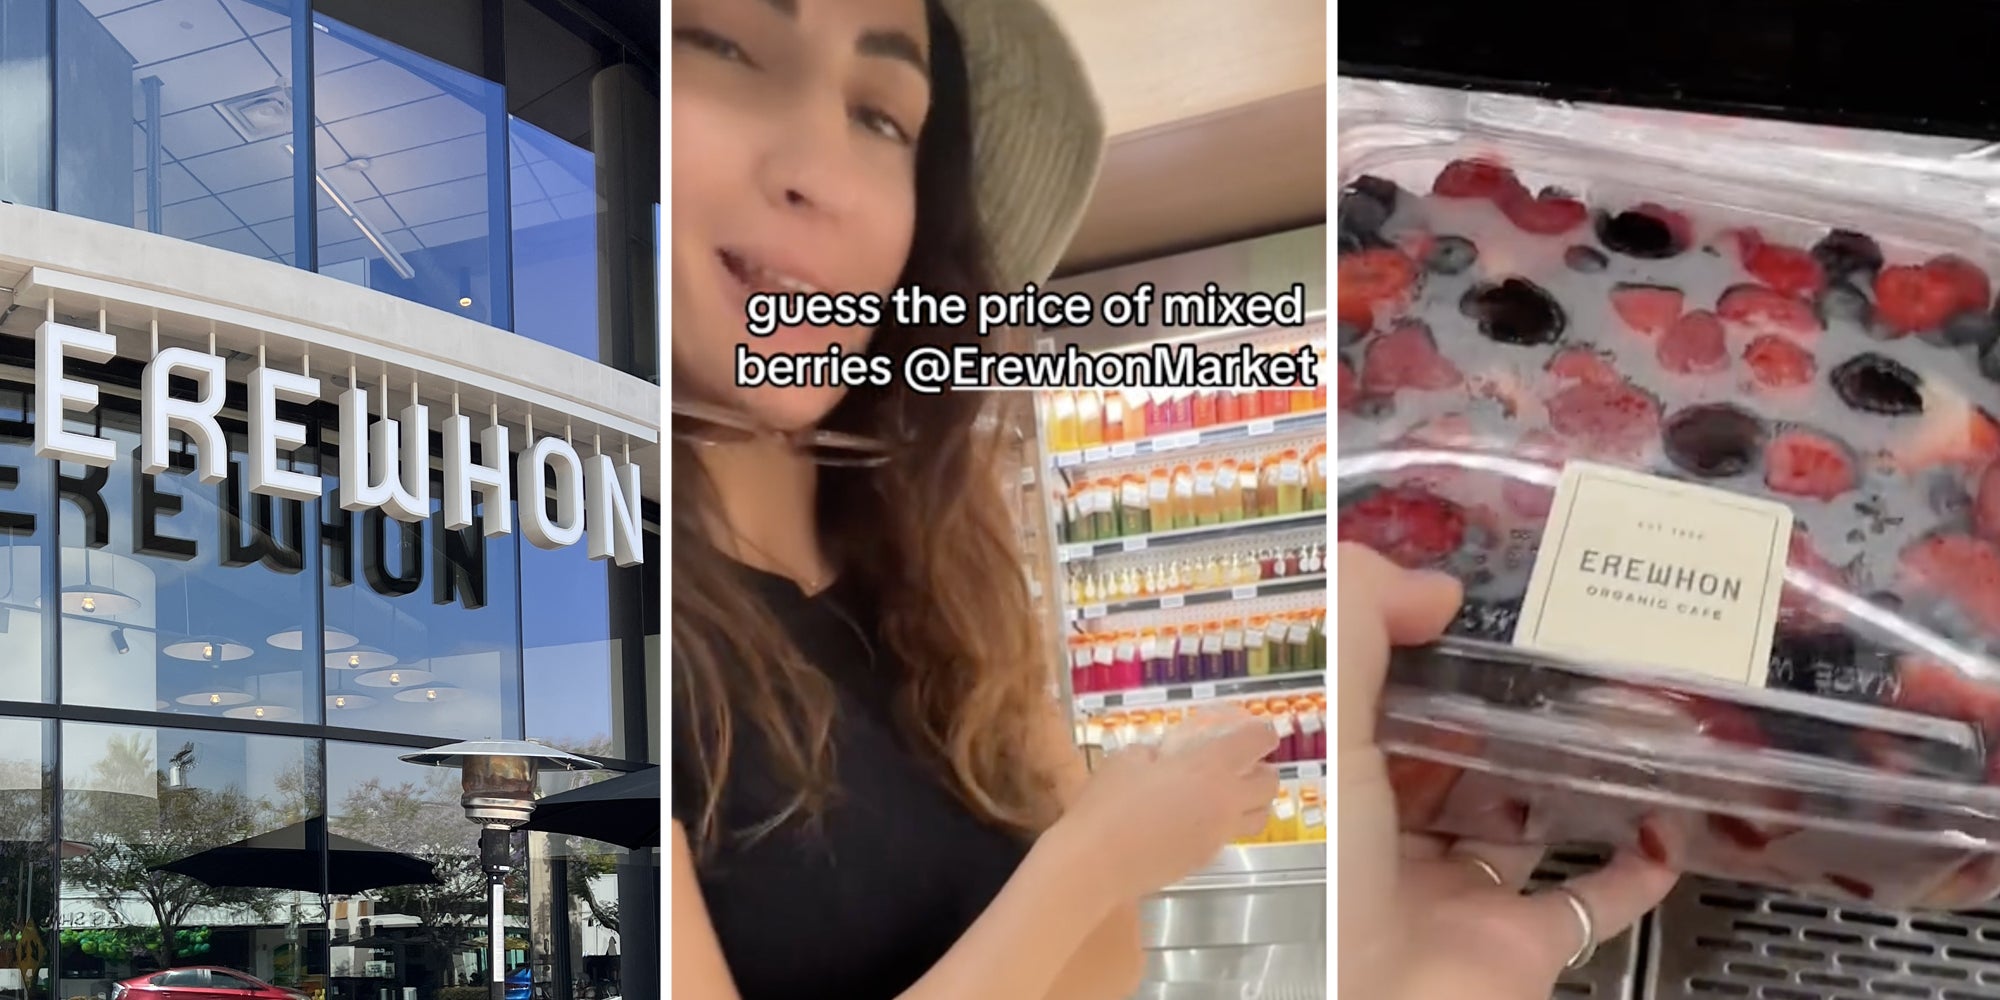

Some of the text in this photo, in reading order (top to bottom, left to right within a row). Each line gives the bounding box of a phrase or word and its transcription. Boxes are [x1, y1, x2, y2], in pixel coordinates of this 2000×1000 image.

[35, 320, 644, 568] EREWHON
[1579, 549, 1743, 602] EREWHON
[1585, 586, 1668, 611] ORGANIC
